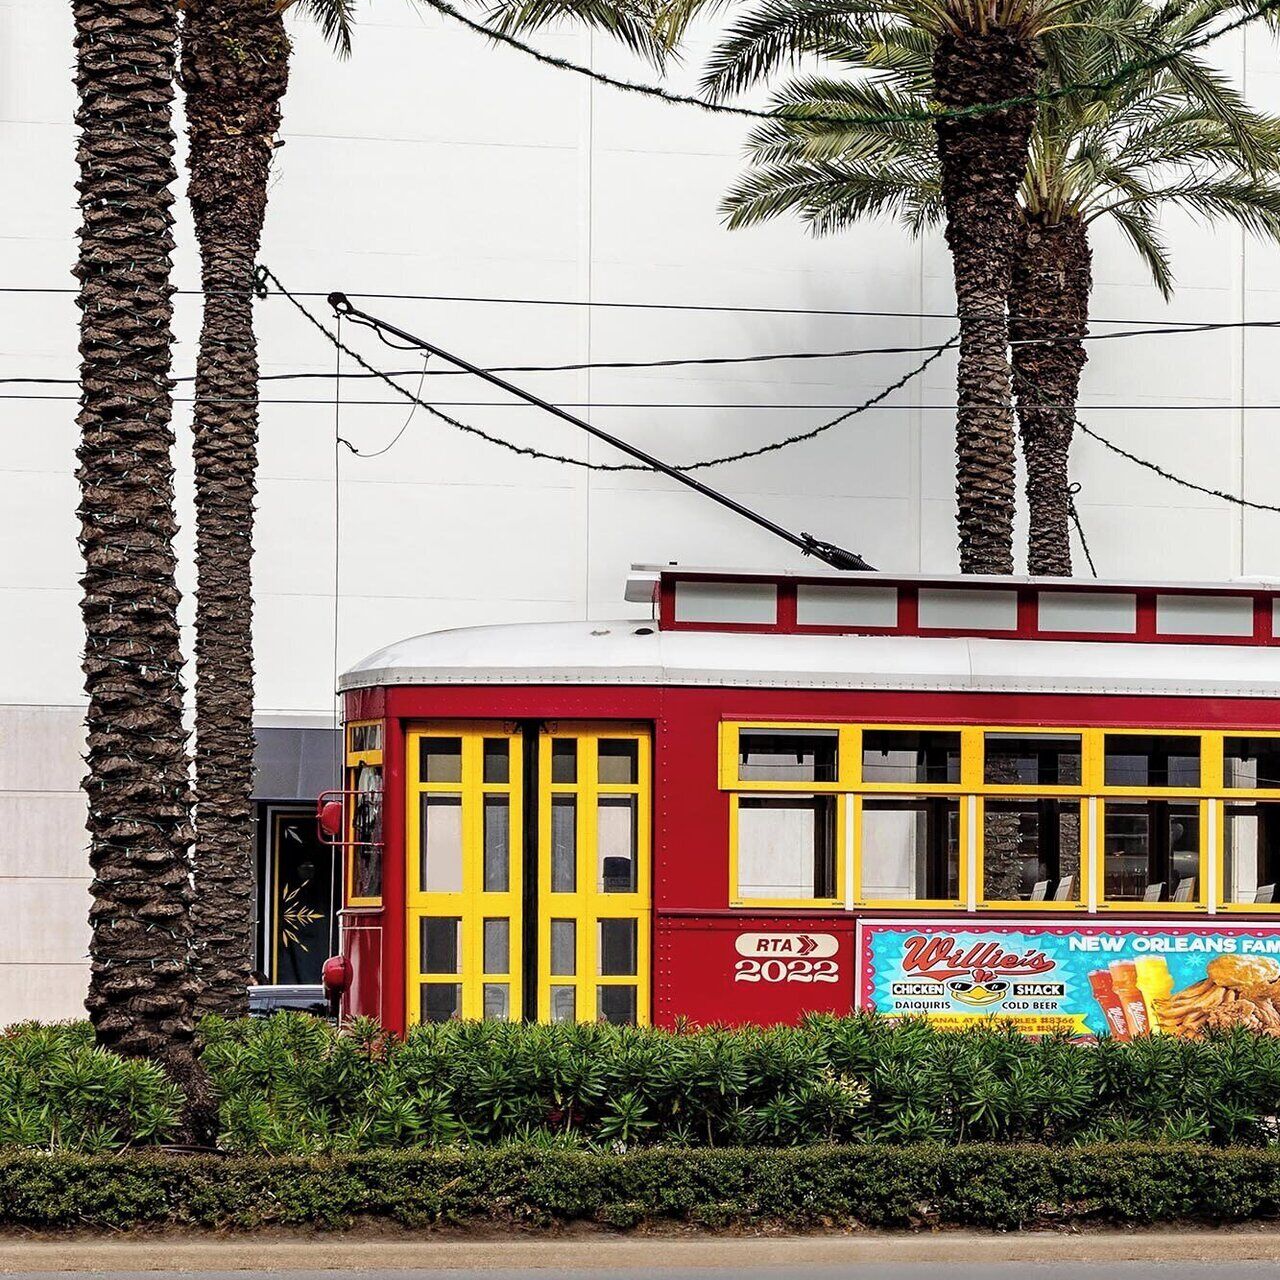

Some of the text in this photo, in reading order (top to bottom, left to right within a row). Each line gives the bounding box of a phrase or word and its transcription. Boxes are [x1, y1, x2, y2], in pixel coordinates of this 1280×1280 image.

[756, 939, 792, 952] RTA
[1069, 936, 1126, 952] NEW
[1131, 937, 1237, 953] ORLEANS
[902, 935, 1056, 974] Willie's
[735, 959, 839, 982] 2022
[893, 985, 1061, 995] CHICKEN SHACK
[895, 1001, 951, 1010] DAIQUIRIS
[1002, 1001, 1058, 1009] COLD BEER
